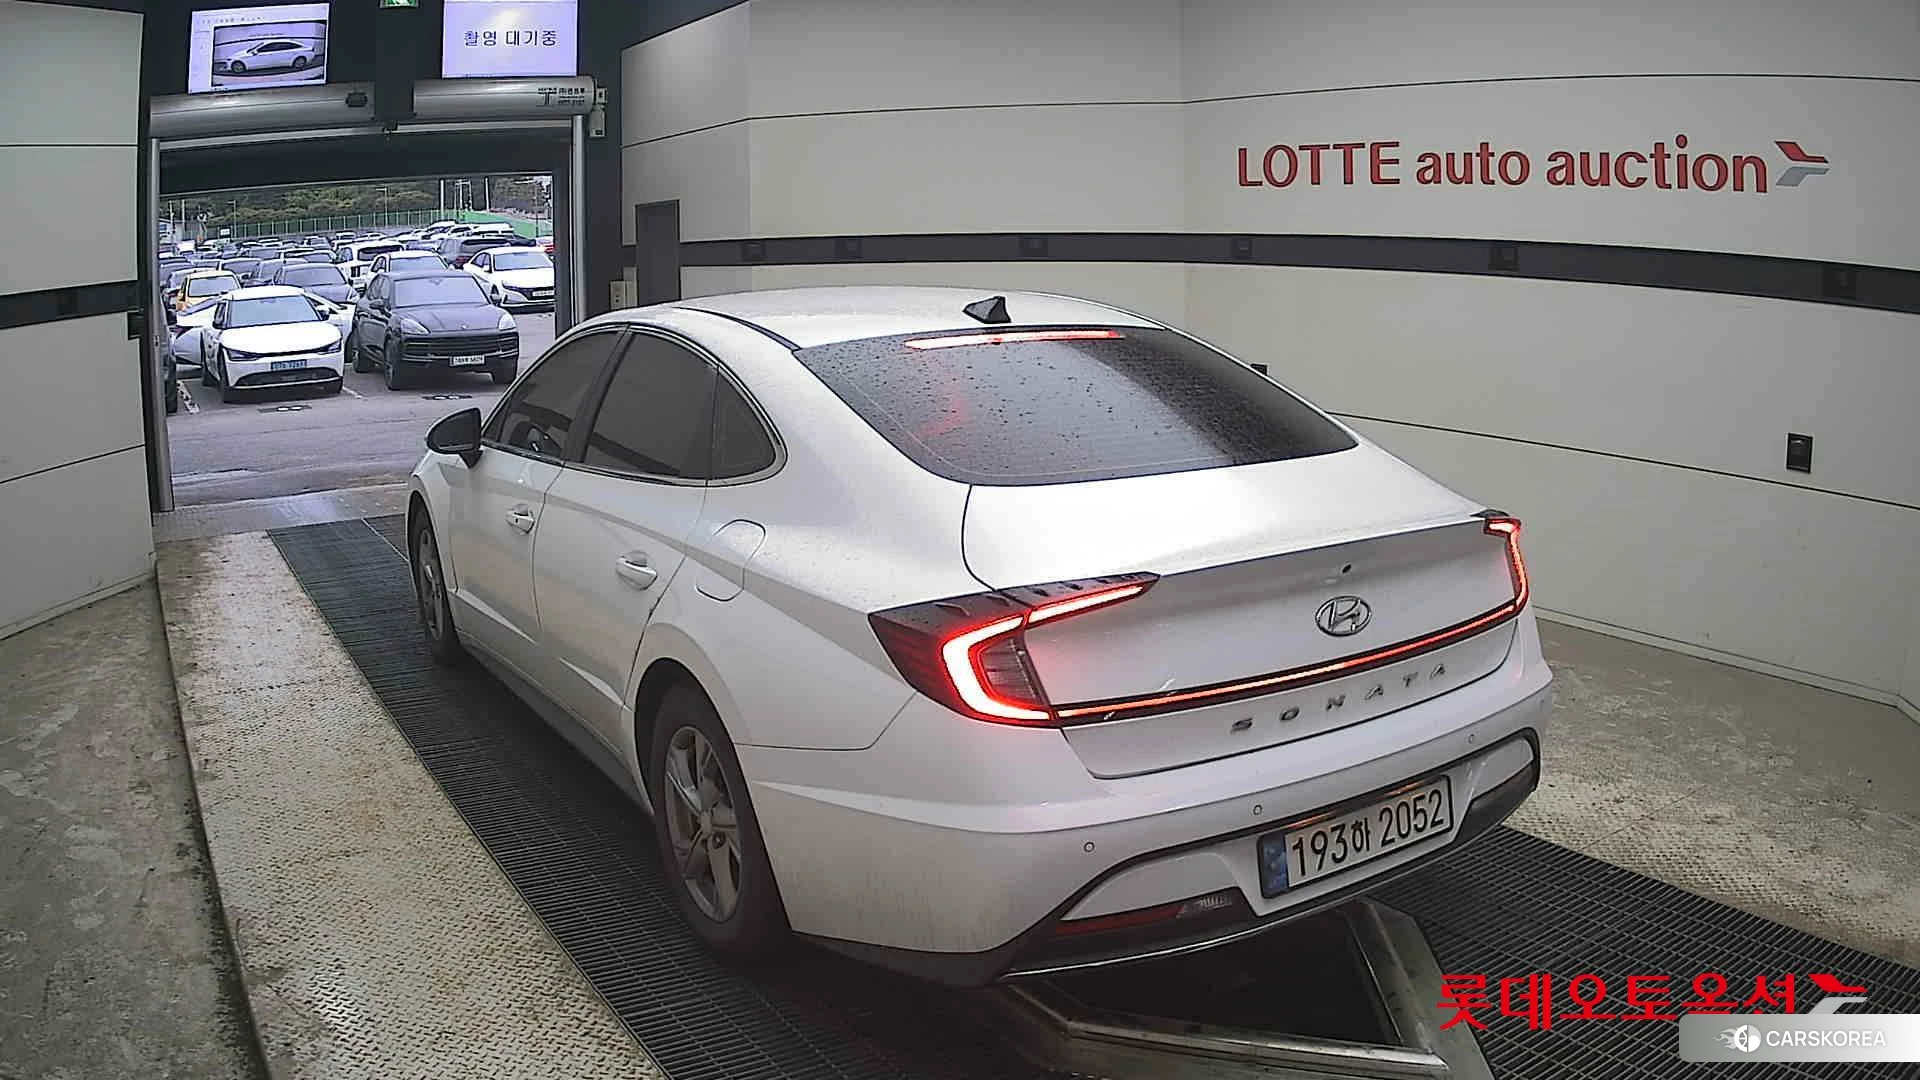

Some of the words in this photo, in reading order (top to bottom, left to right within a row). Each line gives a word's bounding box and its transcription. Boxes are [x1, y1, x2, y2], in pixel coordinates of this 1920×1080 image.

[505, 30, 557, 47] 대기중
[1238, 141, 1400, 188] LOTTE
[1416, 142, 1530, 186] auto
[1546, 134, 1768, 193] auction
[1230, 663, 1447, 734] SONATA
[1292, 817, 1370, 877] 193하
[1378, 789, 1445, 849] 2052
